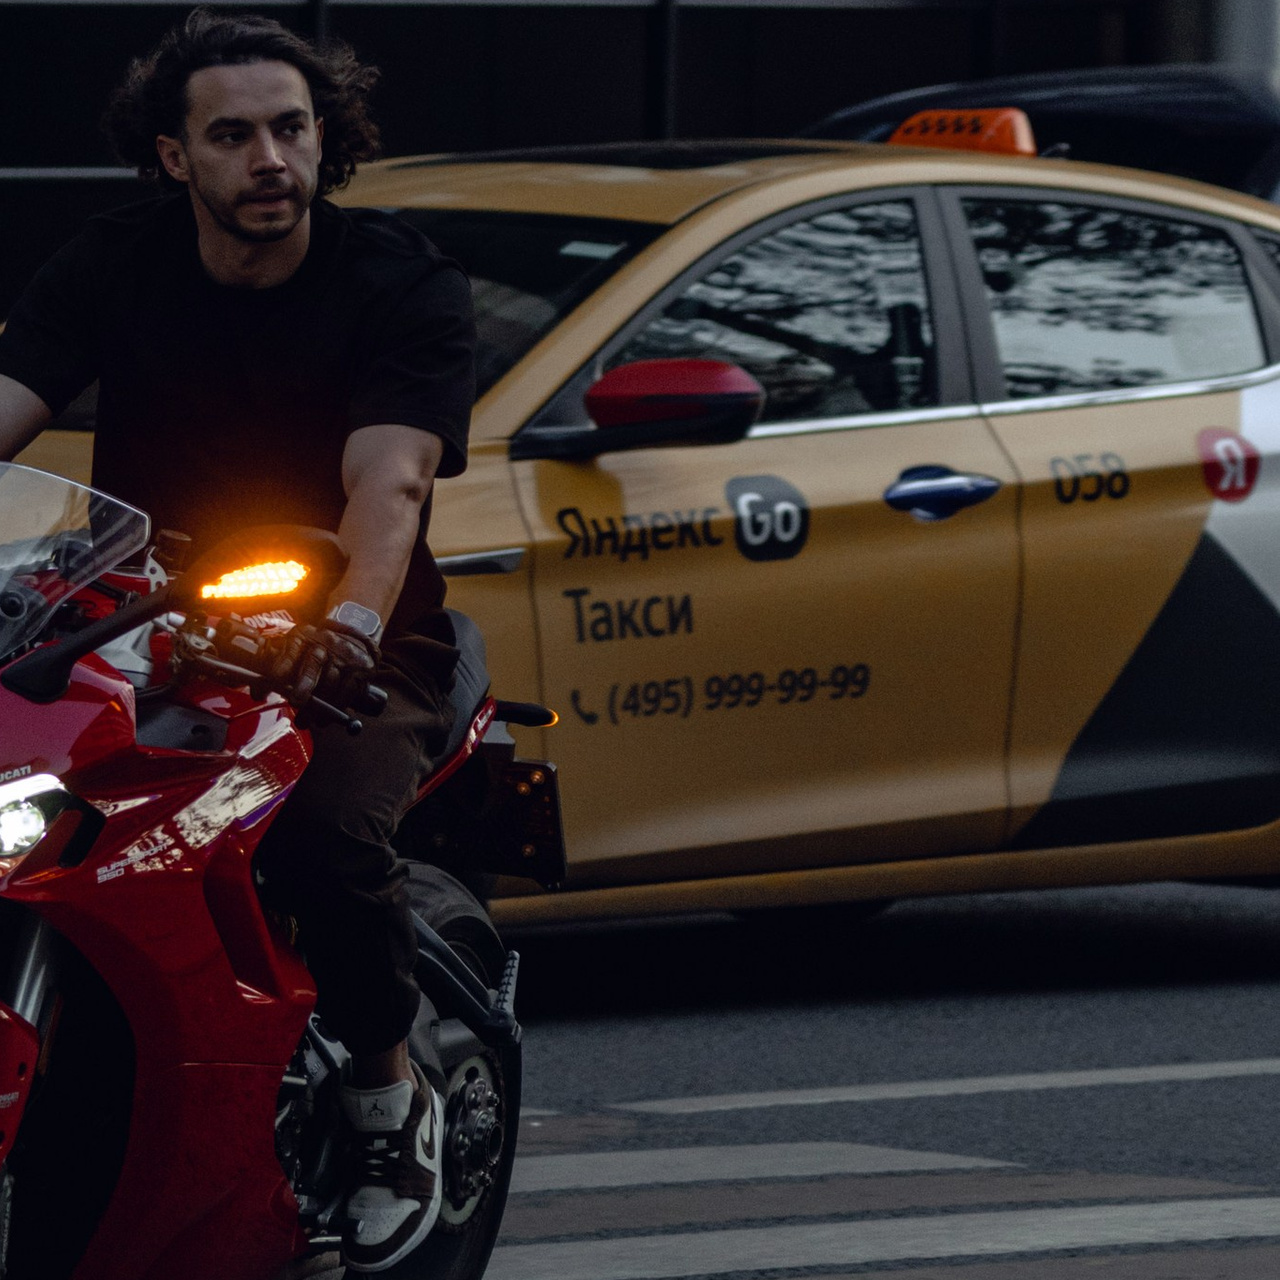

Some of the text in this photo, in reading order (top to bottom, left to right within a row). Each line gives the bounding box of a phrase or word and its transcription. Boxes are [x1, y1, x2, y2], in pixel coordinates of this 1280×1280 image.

[1050, 452, 1130, 503] 058
[557, 492, 803, 561] Яндекс Go
[562, 587, 693, 643] Такси
[609, 663, 871, 725] (495) 999-99-99
[97, 842, 168, 874] SUPERSPORT
